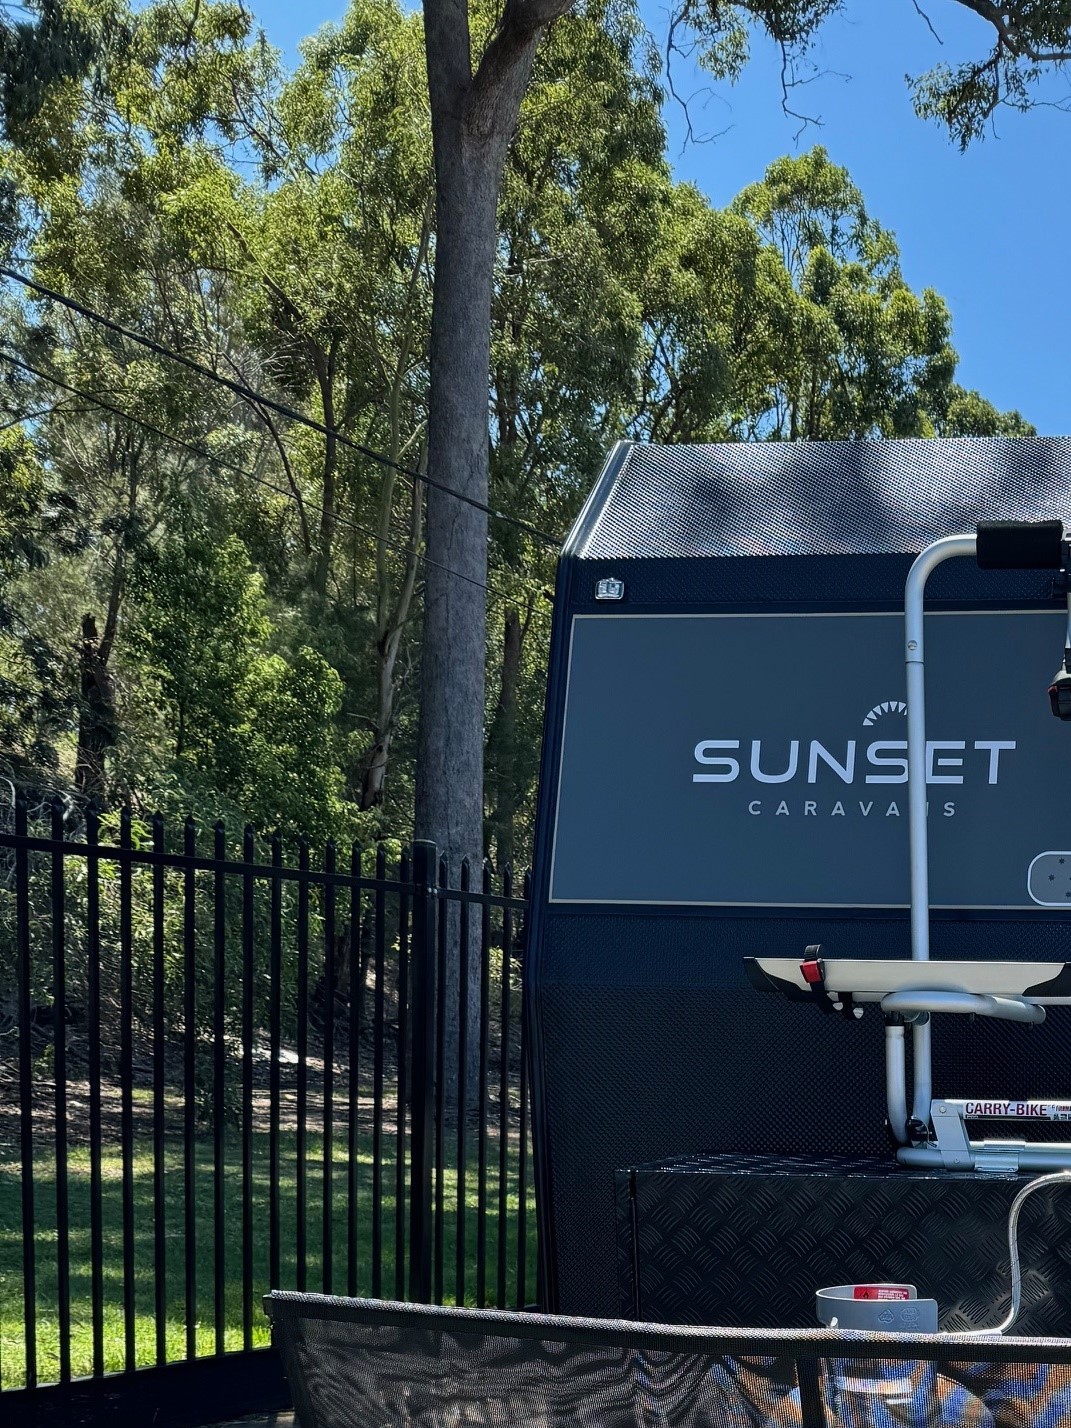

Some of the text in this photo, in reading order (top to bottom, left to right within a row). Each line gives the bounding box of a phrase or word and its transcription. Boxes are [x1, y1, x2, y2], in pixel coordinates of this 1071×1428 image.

[692, 739, 1017, 785] SUNSET
[748, 800, 957, 818] CARAVAS
[965, 1102, 1048, 1117] CARRY-BIKE
